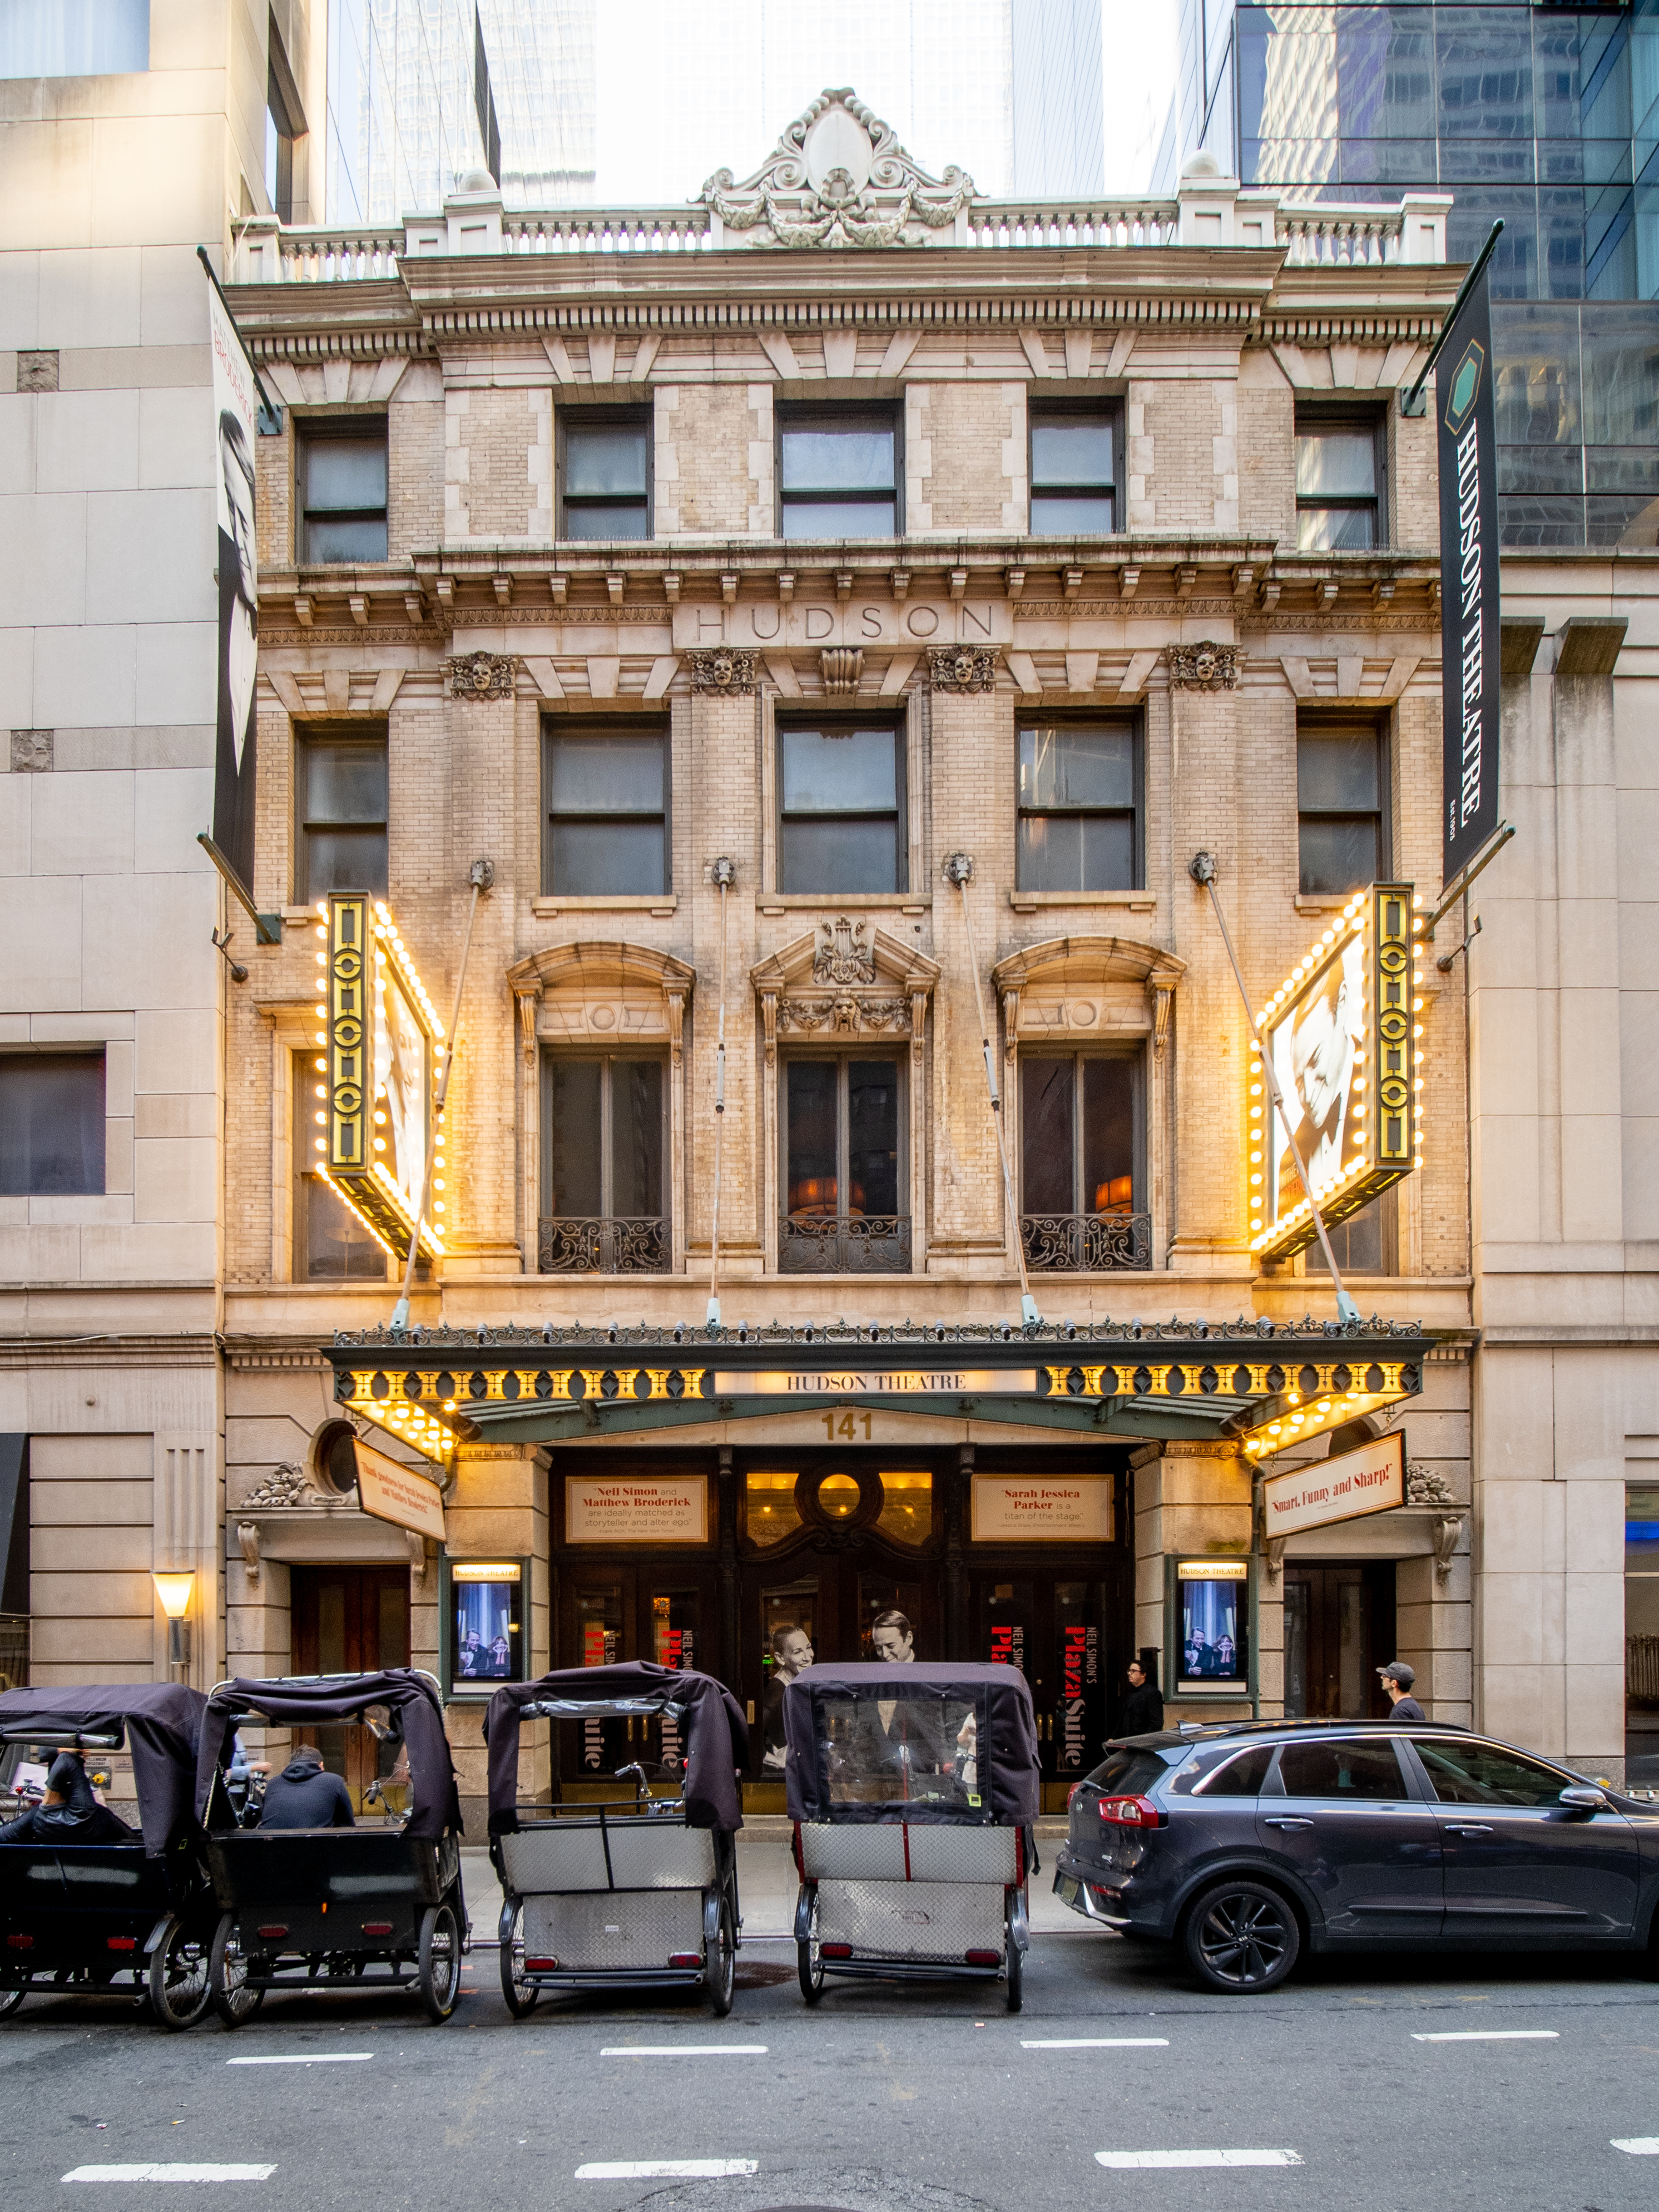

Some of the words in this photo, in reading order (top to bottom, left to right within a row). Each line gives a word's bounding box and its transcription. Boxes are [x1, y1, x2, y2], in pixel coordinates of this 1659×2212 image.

[1457, 417, 1482, 620] HUDSON
[695, 606, 993, 641] HUDSON
[1462, 607, 1483, 828] THEATRE
[787, 1376, 868, 1390] HUDSON
[874, 1375, 966, 1389] THEATRE
[821, 1413, 872, 1441] 141
[622, 1487, 658, 1496] Simon
[1041, 1489, 1080, 1498] Jessica
[1302, 1487, 1330, 1506] Funny
[1333, 1476, 1351, 1496] and
[583, 1498, 630, 1507] Matthew
[633, 1497, 691, 1506] Broderick
[1013, 1501, 1053, 1510] Parker
[585, 1518, 628, 1527] storyteller
[604, 1509, 632, 1517] ideally
[605, 1630, 615, 1649] NEIL
[682, 1630, 693, 1649] NEIL
[1013, 1626, 1023, 1646] NEIL
[1086, 1627, 1097, 1646] NEIL
[1065, 1626, 1086, 1698] Plaza
[1086, 1649, 1097, 1684] SIMON'S
[1065, 1699, 1086, 1766] Suite
[585, 1718, 605, 1769] uite
[661, 1717, 683, 1769] uite
